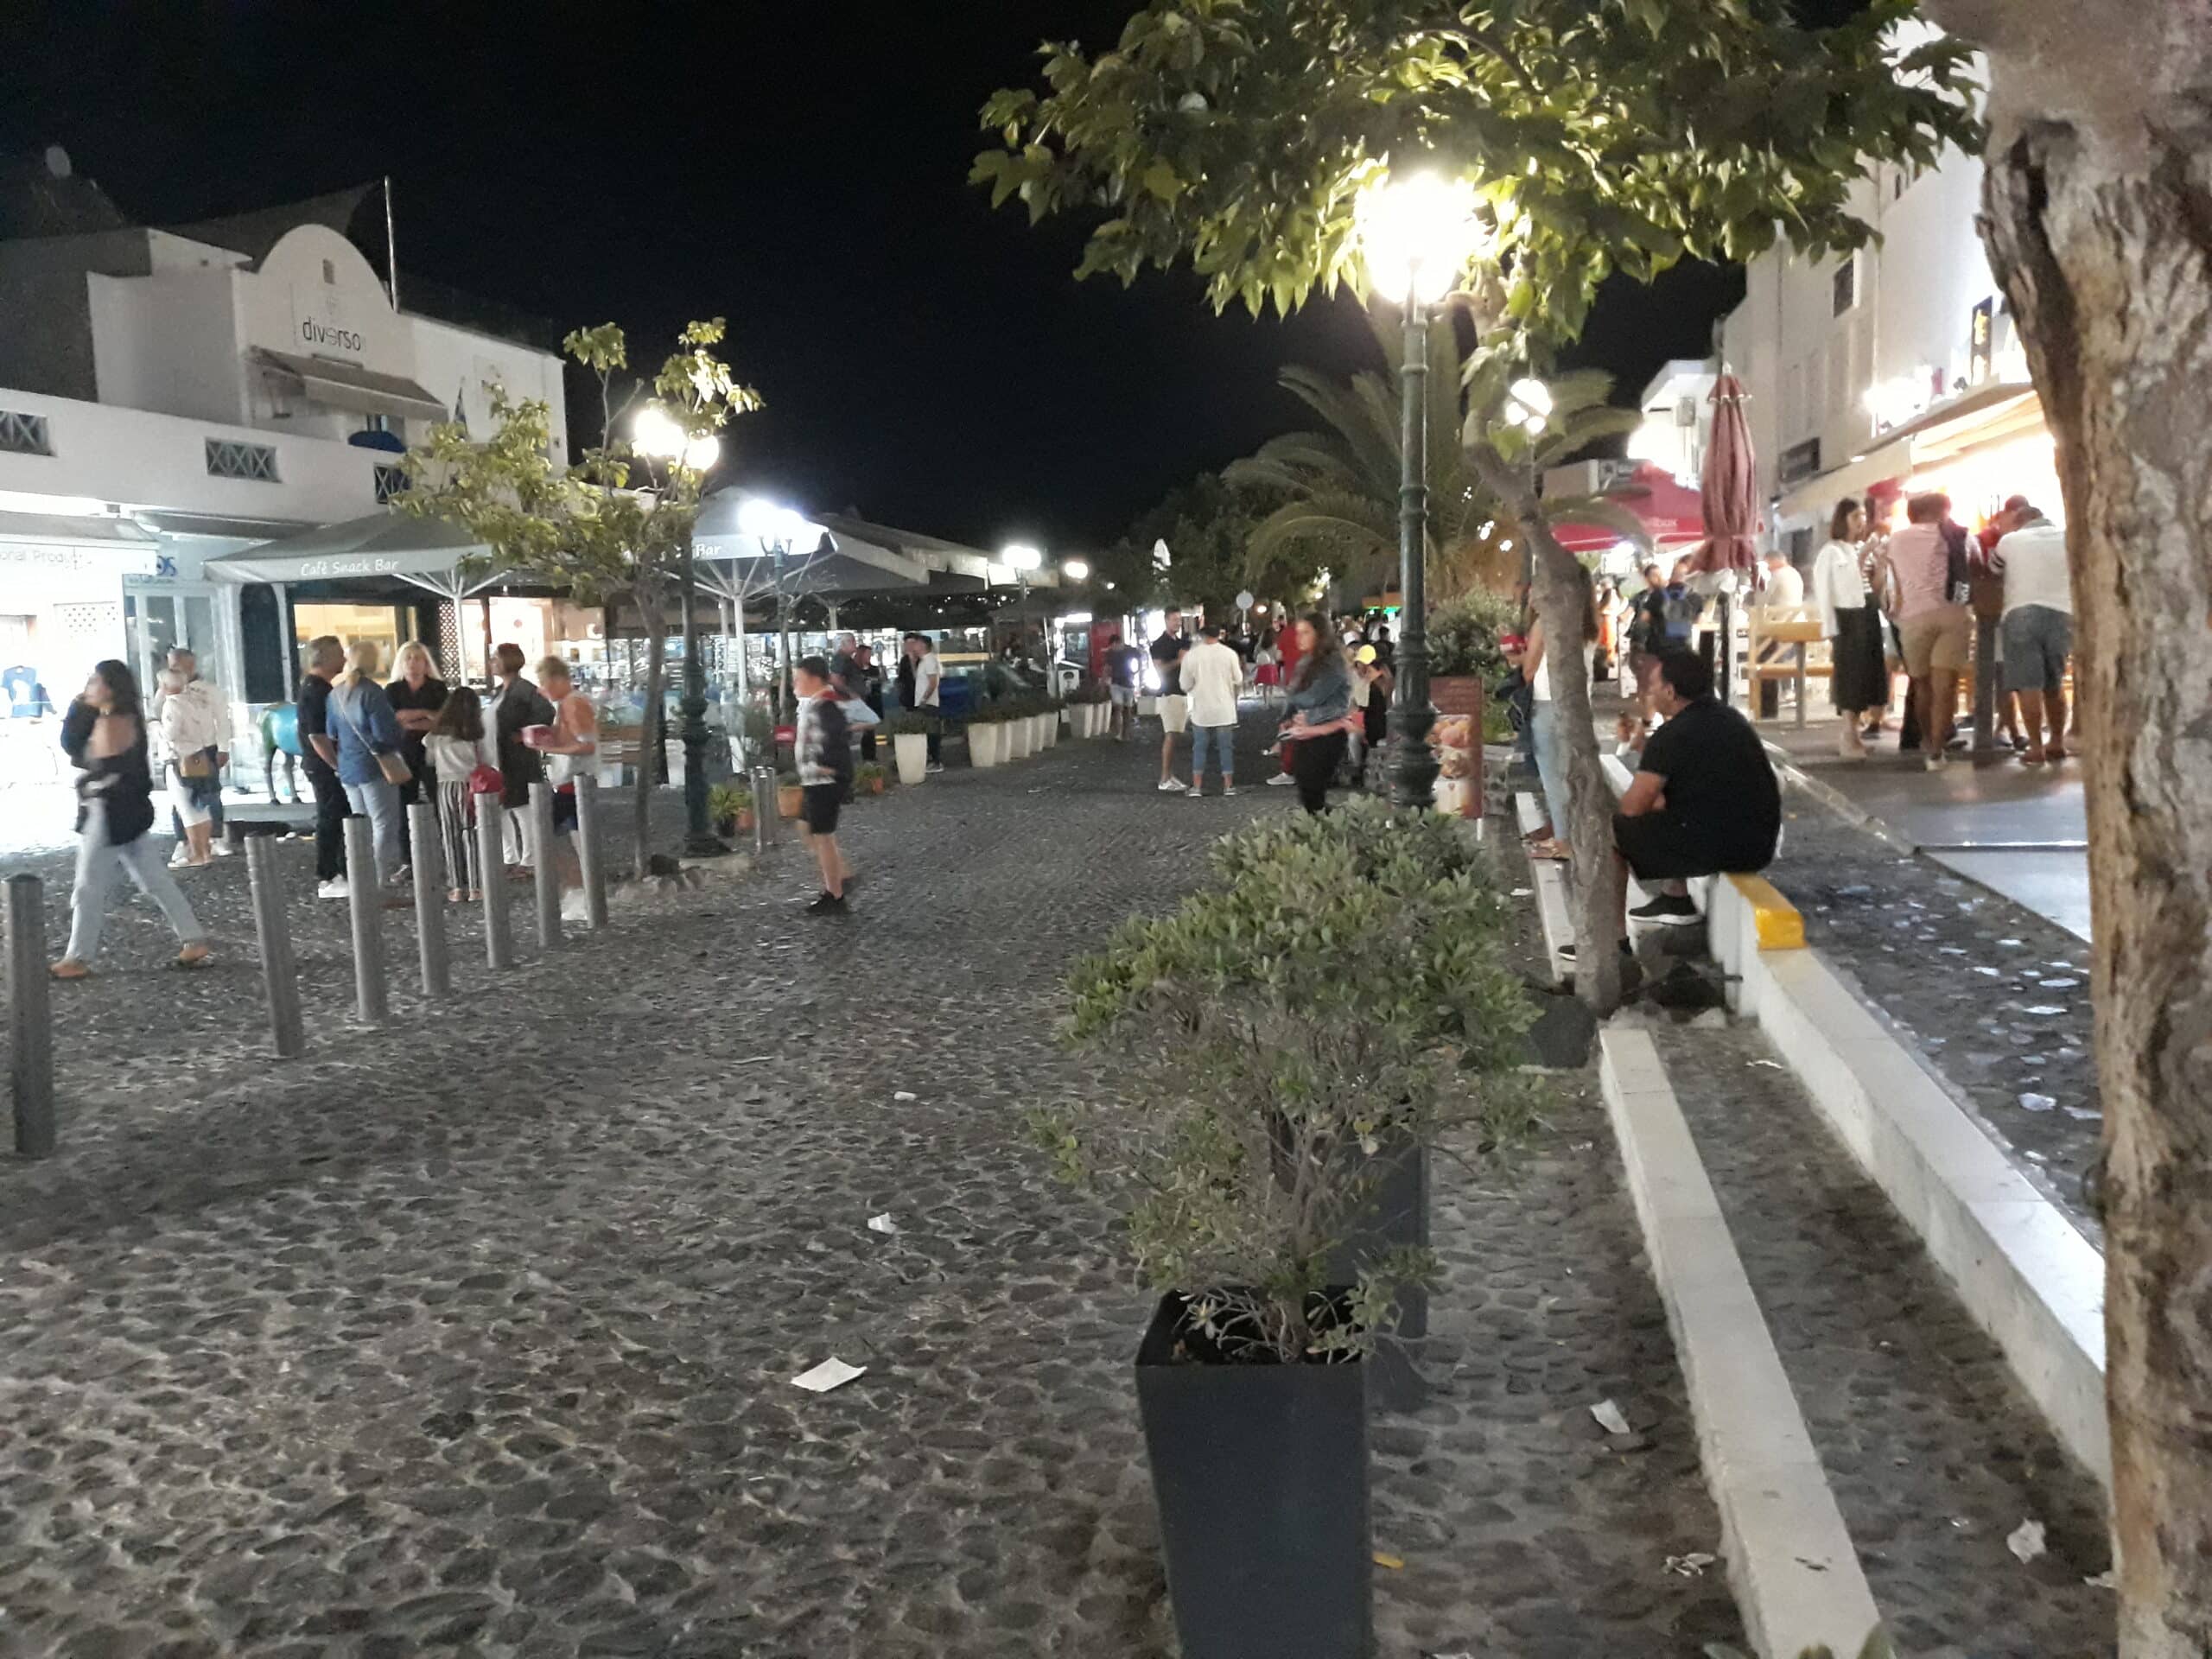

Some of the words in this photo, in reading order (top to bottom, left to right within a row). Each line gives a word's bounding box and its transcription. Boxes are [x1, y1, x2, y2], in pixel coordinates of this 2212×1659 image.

[302, 316, 361, 351] diverso
[695, 543, 721, 558] Bar
[332, 559, 371, 575] Snack
[374, 558, 399, 571] Bar
